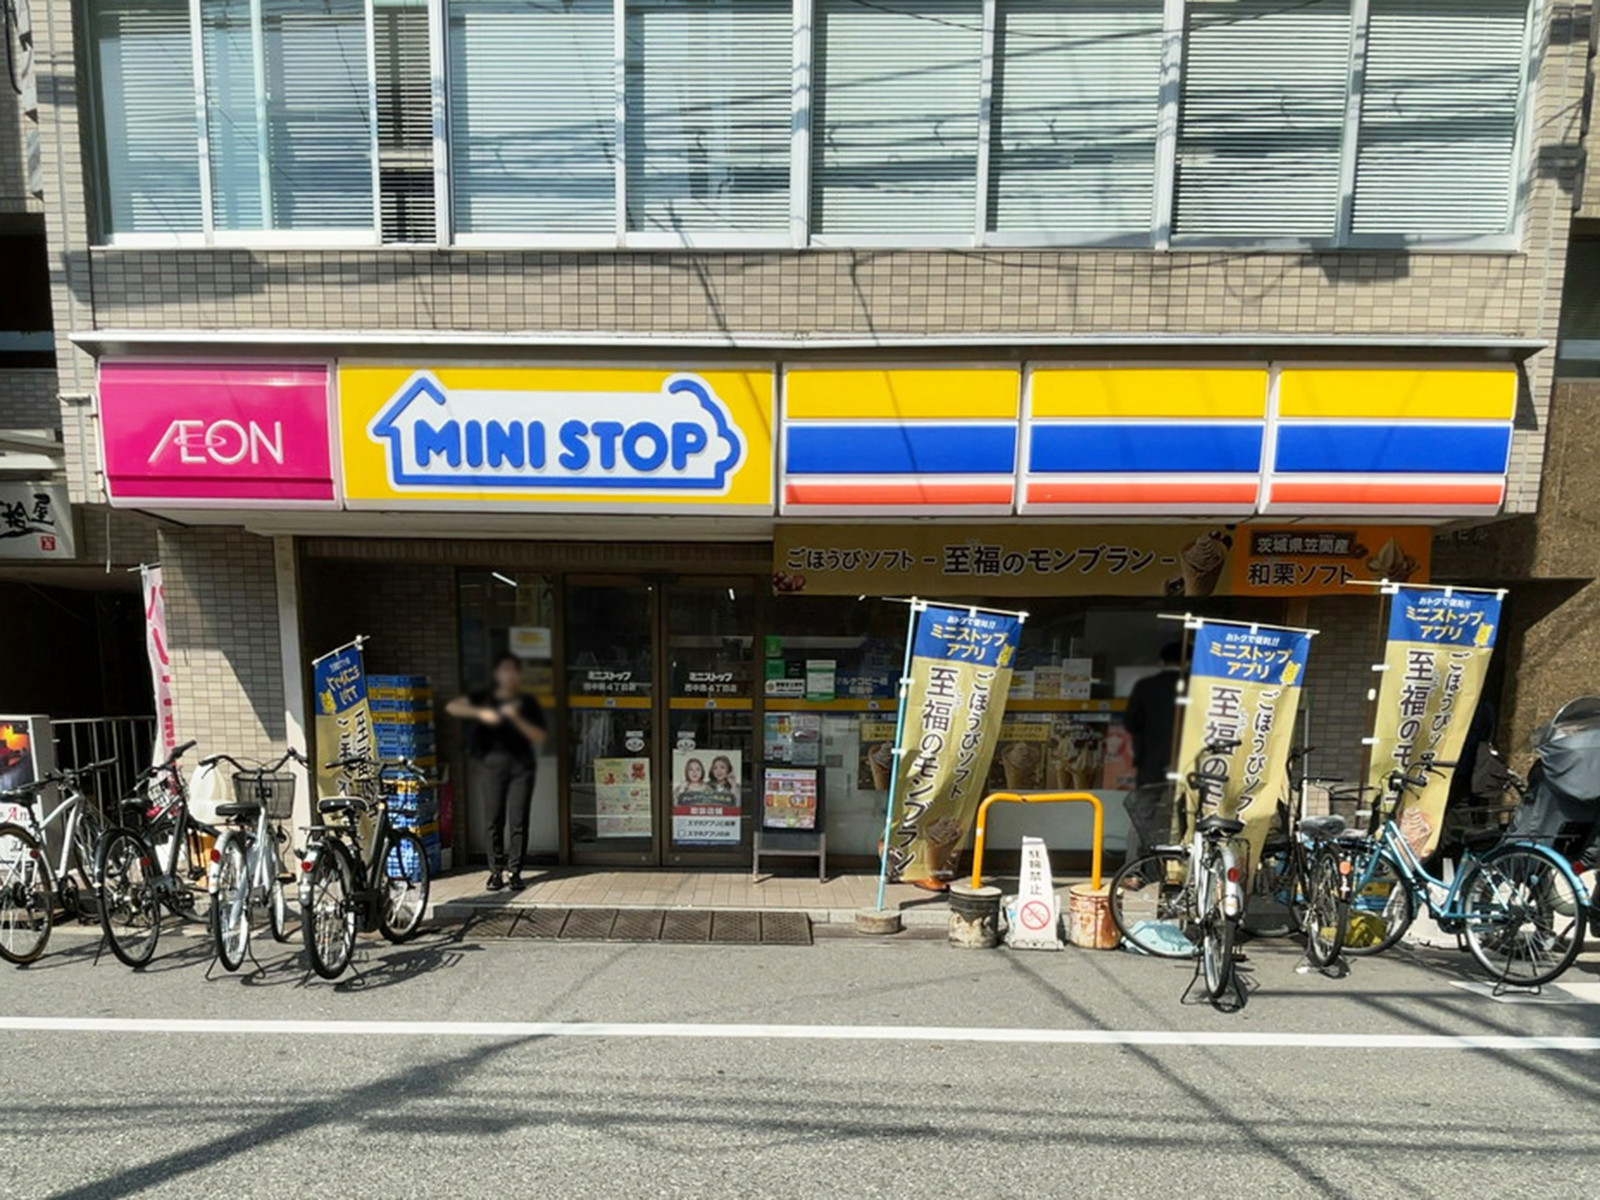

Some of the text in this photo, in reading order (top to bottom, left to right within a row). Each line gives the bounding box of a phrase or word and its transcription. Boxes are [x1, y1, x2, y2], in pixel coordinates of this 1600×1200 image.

[414, 419, 708, 472] MINI STOP
[786, 544, 1154, 576] ごほうびソフト 至福のモンブラン
[1248, 562, 1354, 585] 和栗ソフト
[1406, 606, 1485, 625] ミニストップ
[930, 623, 1008, 647] ミニストップ
[1420, 625, 1463, 640] アプリ
[946, 643, 986, 660] アプリ
[1209, 641, 1292, 664] ミニストップ
[587, 671, 632, 681] ミニストップ
[689, 672, 733, 682] ミニストップ
[1227, 661, 1270, 679] アプリ
[950, 671, 994, 798] ごほうびソフト
[895, 666, 958, 872] 至福のモンブラン
